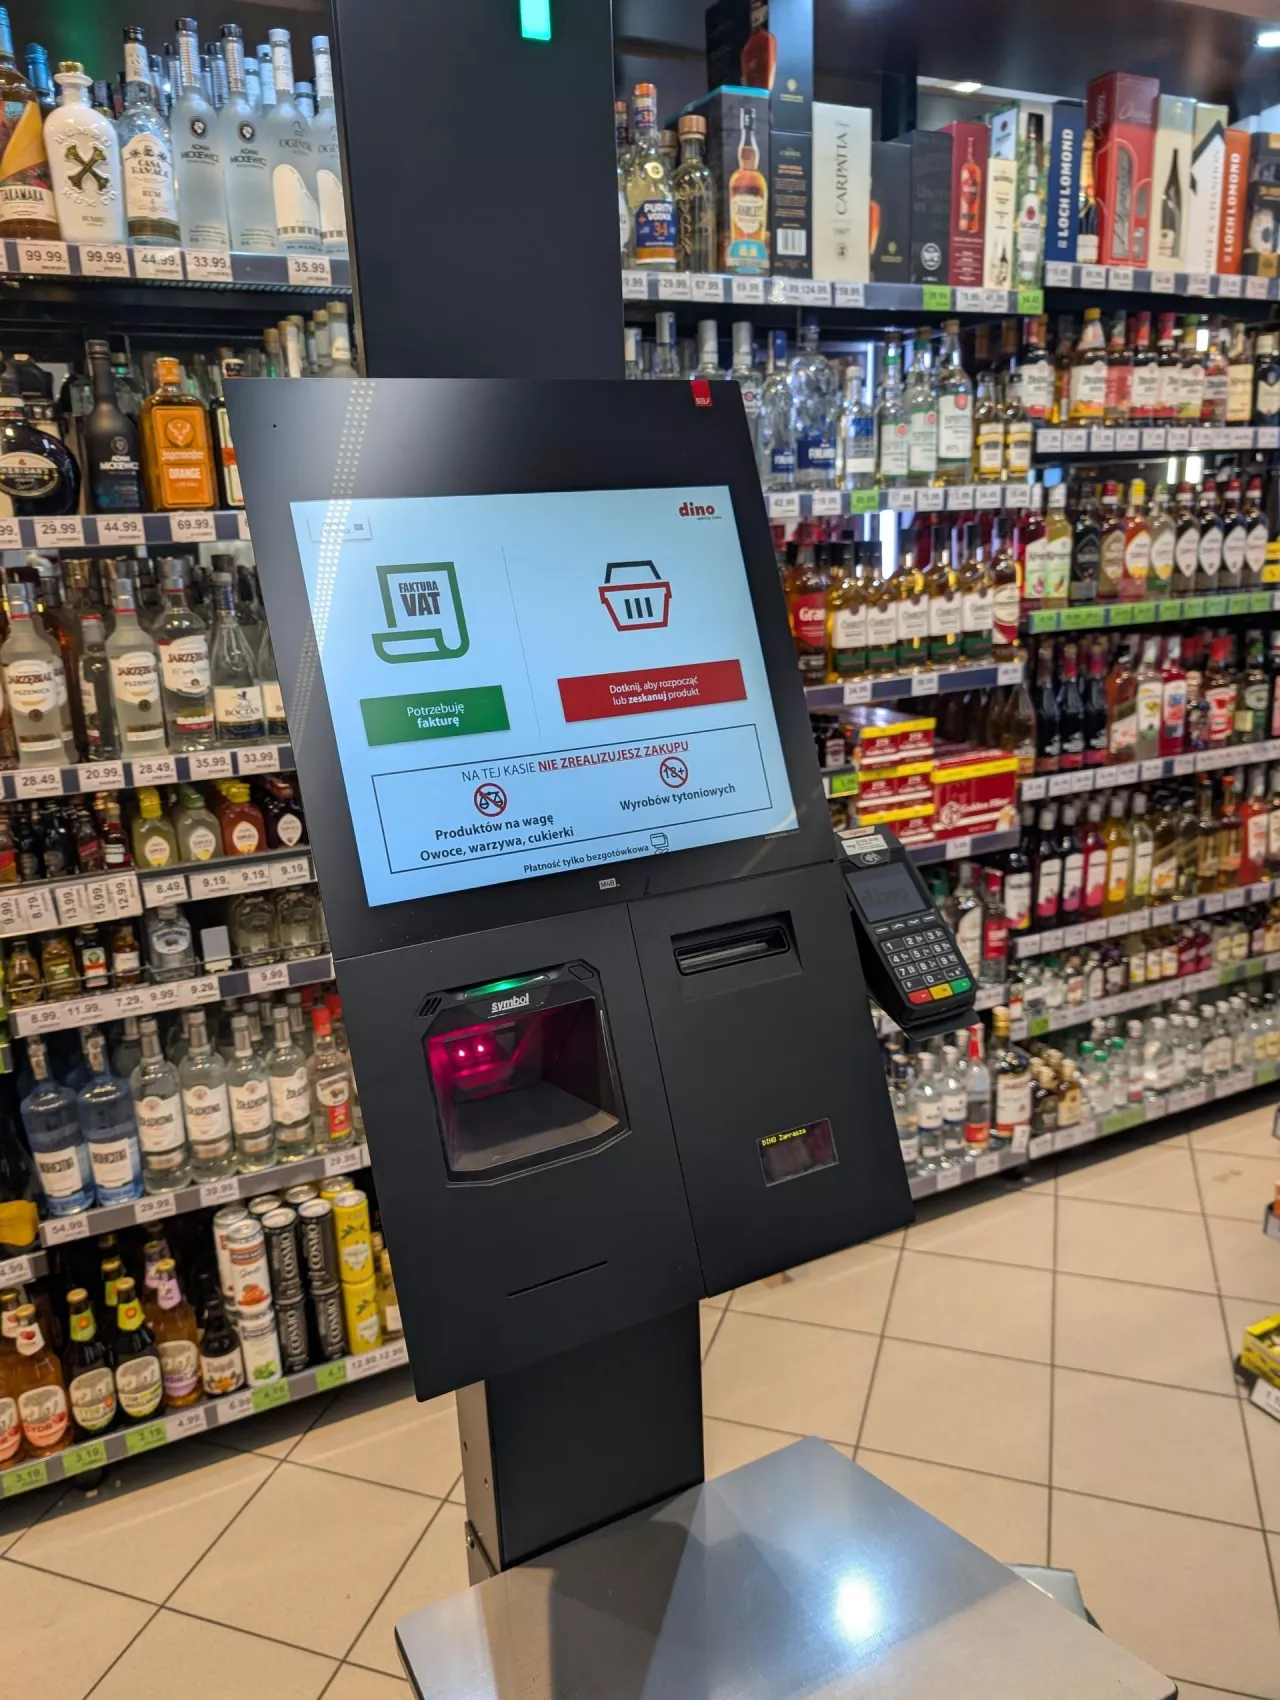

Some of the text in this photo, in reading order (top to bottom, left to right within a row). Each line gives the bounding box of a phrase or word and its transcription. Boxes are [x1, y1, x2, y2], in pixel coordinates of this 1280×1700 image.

[834, 130, 849, 216] CARPATIA
[1058, 128, 1074, 238] LOCH LOMOND
[1223, 153, 1241, 253] LOCH LOMOND
[25, 250, 62, 262] 99.99
[86, 250, 123, 263] 99.99
[141, 253, 175, 266] 44.99
[194, 256, 227, 268] 33.99
[294, 261, 325, 273] 35.99
[695, 397, 711, 405] SELF
[679, 501, 716, 517] dino
[41, 523, 77, 535] 29.99
[104, 521, 138, 532] 44.99
[177, 519, 210, 530] 69.99
[398, 581, 439, 593] FAKTURA
[400, 592, 441, 617] VAT
[609, 675, 698, 694] Dotknij, aby rozpocząć
[613, 687, 700, 706] lub zeskanuj produkt
[406, 702, 465, 717] Potrzebuję
[417, 715, 460, 729] fakturę
[196, 757, 227, 768] 35.99
[244, 752, 274, 763] 33.99
[461, 740, 690, 783] NA TEJ KASIE NIE ZREALIZUJESZ ZAKUPU
[86, 768, 119, 780] 20.99
[139, 763, 170, 775] 28.49
[22, 775, 56, 787] 28.49
[620, 783, 736, 812] Wyrobów tytoniowych
[435, 814, 555, 841] Produktów na wagę
[420, 827, 575, 862] Owoce, warzywa, cukierki
[523, 845, 650, 874] Płatność tylko bezgotówkowa
[242, 869, 267, 881] 9.19
[281, 863, 304, 875] 9.19
[156, 881, 181, 894] 8.49
[202, 876, 226, 887] 9.19
[115, 882, 129, 910] 12.99
[63, 892, 78, 920] 13.99
[260, 970, 283, 981] 9.99
[191, 982, 214, 993] 9.29
[116, 995, 140, 1007] 7.29
[151, 989, 175, 1001] 9.99
[491, 992, 530, 1013] symbol
[67, 1003, 99, 1015] 11.99
[762, 1136, 777, 1146] DINO
